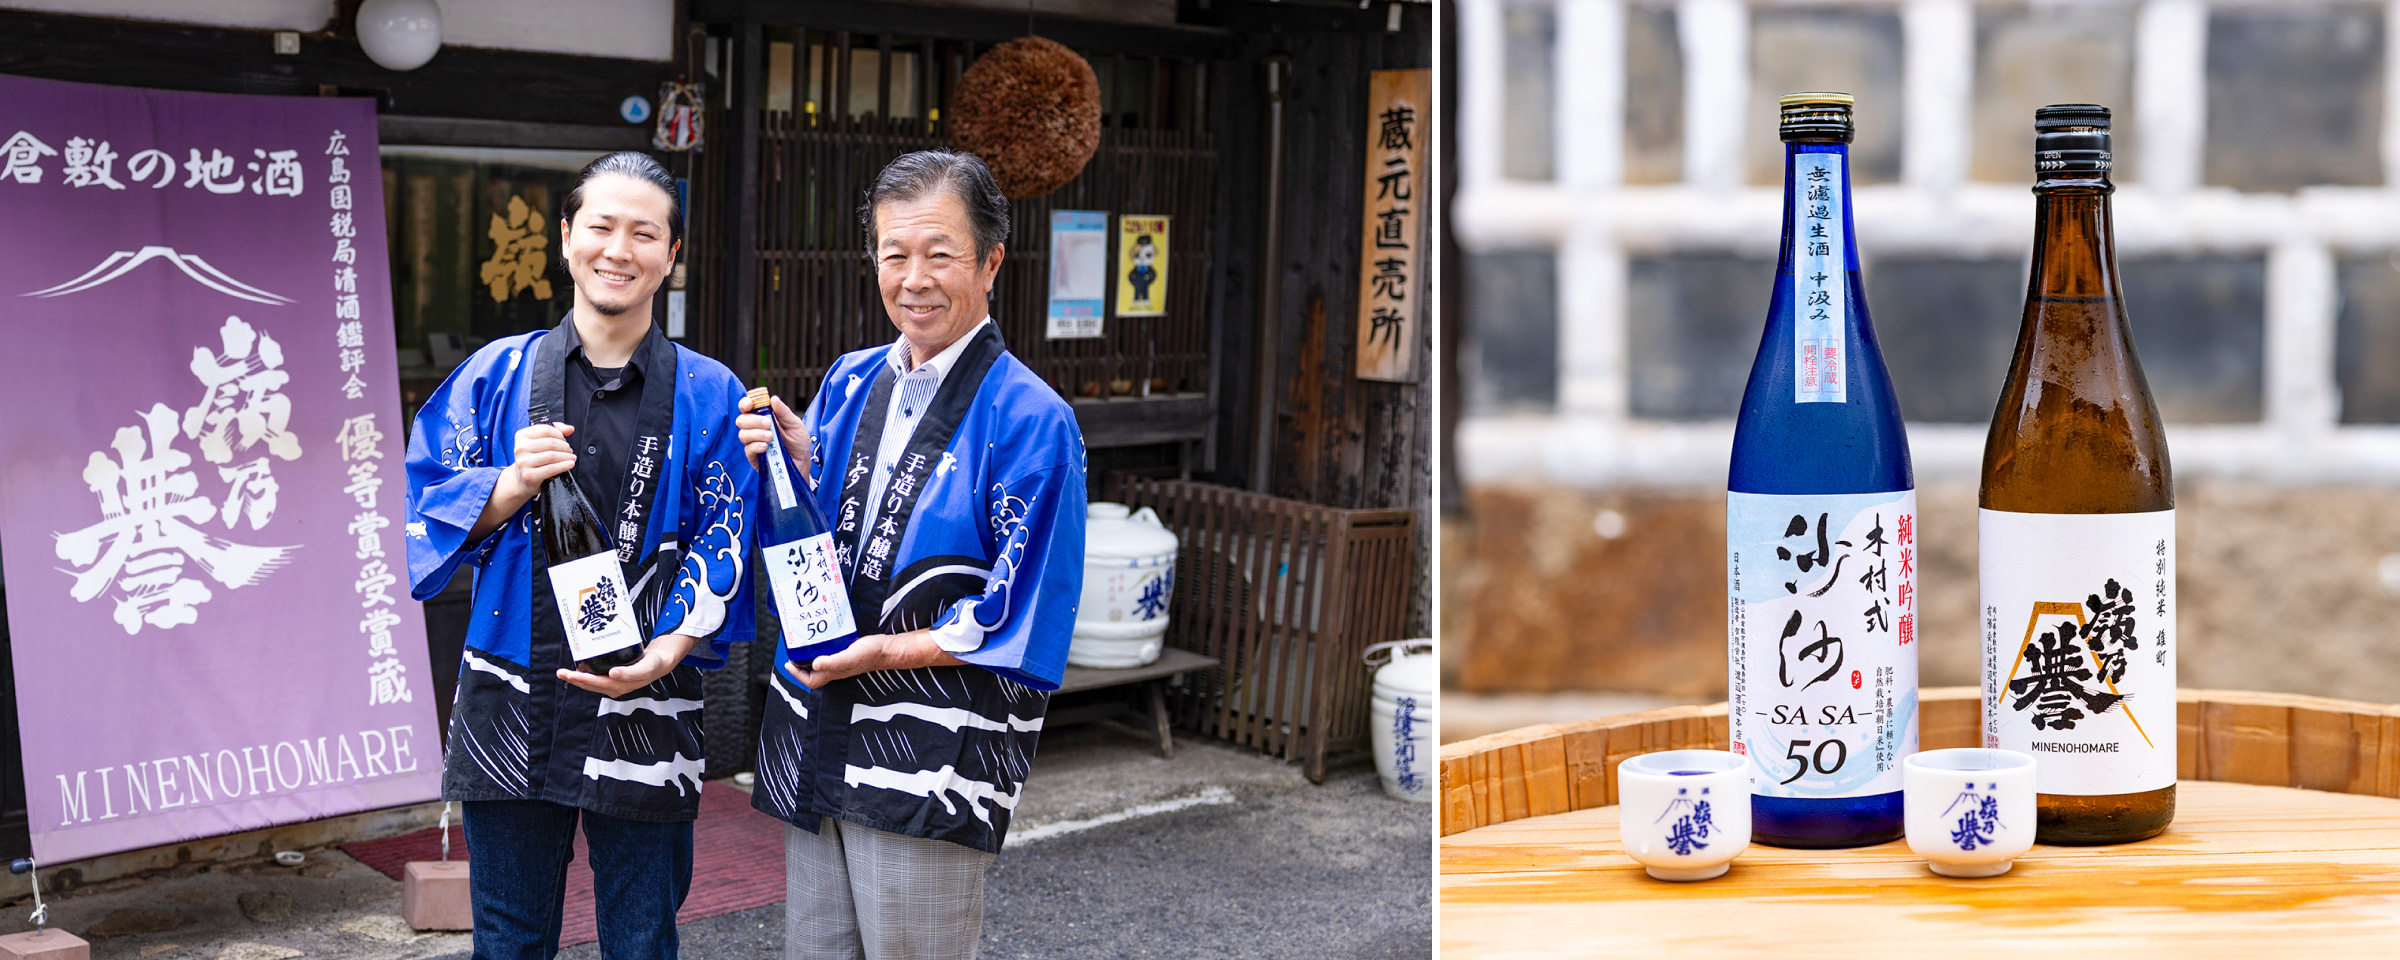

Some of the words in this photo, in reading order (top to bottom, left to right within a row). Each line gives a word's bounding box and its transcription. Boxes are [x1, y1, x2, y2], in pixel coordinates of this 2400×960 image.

[0, 130, 304, 197] 倉敷の地酒
[1369, 105, 1415, 352] 蔵元直売所
[1807, 166, 1832, 257] 無濾過生酒
[325, 129, 368, 400] 広島国税局清酒鑑評会
[1808, 272, 1832, 321] 中汲み
[1803, 344, 1818, 387] 開栓注意
[1823, 347, 1838, 384] 要冷蔵
[616, 435, 659, 563] 手造り本醸造
[861, 452, 927, 582] 手造り本醸造
[335, 412, 413, 707] 優等賞受賞蔵
[1733, 552, 1741, 592] 日本酒
[1859, 512, 1890, 633] 木村式
[1897, 514, 1914, 647] 純米吟醸
[2156, 539, 2166, 617] 特別純米
[807, 619, 828, 640] 50
[2156, 628, 2166, 667] 雄町
[56, 725, 418, 826] MINENOHOMARE
[1780, 739, 1847, 786] 50
[2031, 741, 2120, 753] MINENOHOMARE
